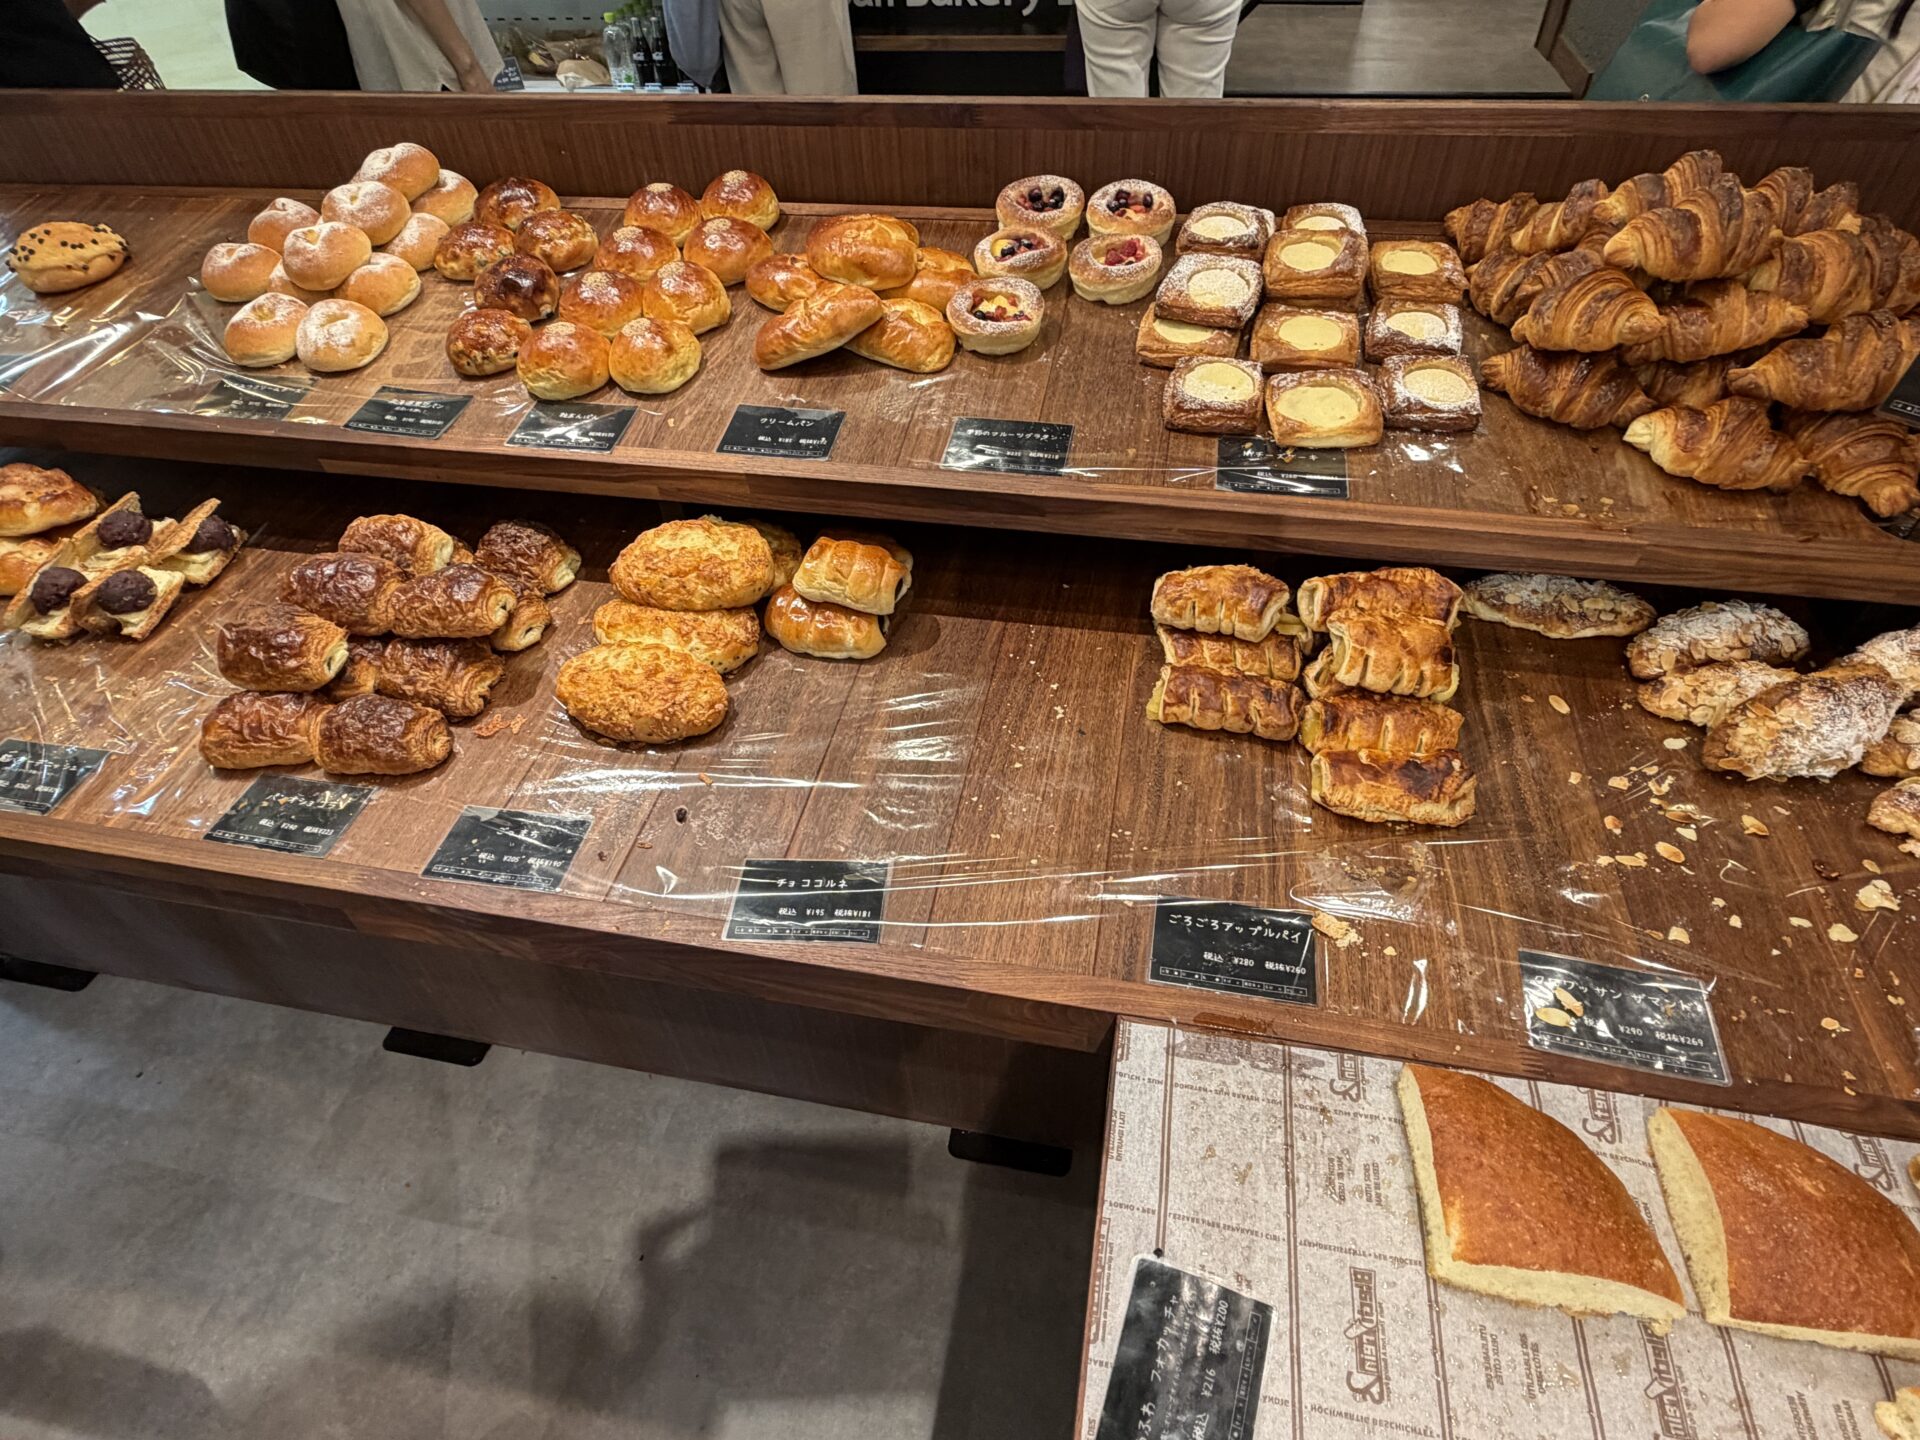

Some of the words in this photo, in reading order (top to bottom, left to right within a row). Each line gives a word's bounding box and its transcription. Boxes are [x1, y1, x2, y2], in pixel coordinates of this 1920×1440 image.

[760, 418, 815, 427] クリームパン
[478, 852, 496, 861] 税込
[502, 855, 520, 863] ¥205
[776, 877, 849, 889] チョココルネ
[778, 907, 797, 917] 税込
[805, 907, 825, 917] ¥195
[834, 908, 872, 918] 税抜¥181
[1168, 913, 1303, 944] ごろごろアップルパイ
[1202, 950, 1225, 964] 税込
[1231, 955, 1255, 968] ¥280
[1264, 960, 1307, 976] 税抜¥260
[1617, 1024, 1644, 1038] ¥290
[1655, 1029, 1705, 1048] 税抜¥269
[1364, 1184, 1373, 1203] BOTH
[1150, 1294, 1181, 1383] フォカッチャ
[1208, 1299, 1229, 1355] 税抜¥200
[1200, 1367, 1217, 1398] ¥216
[1189, 1412, 1210, 1440] 税込
